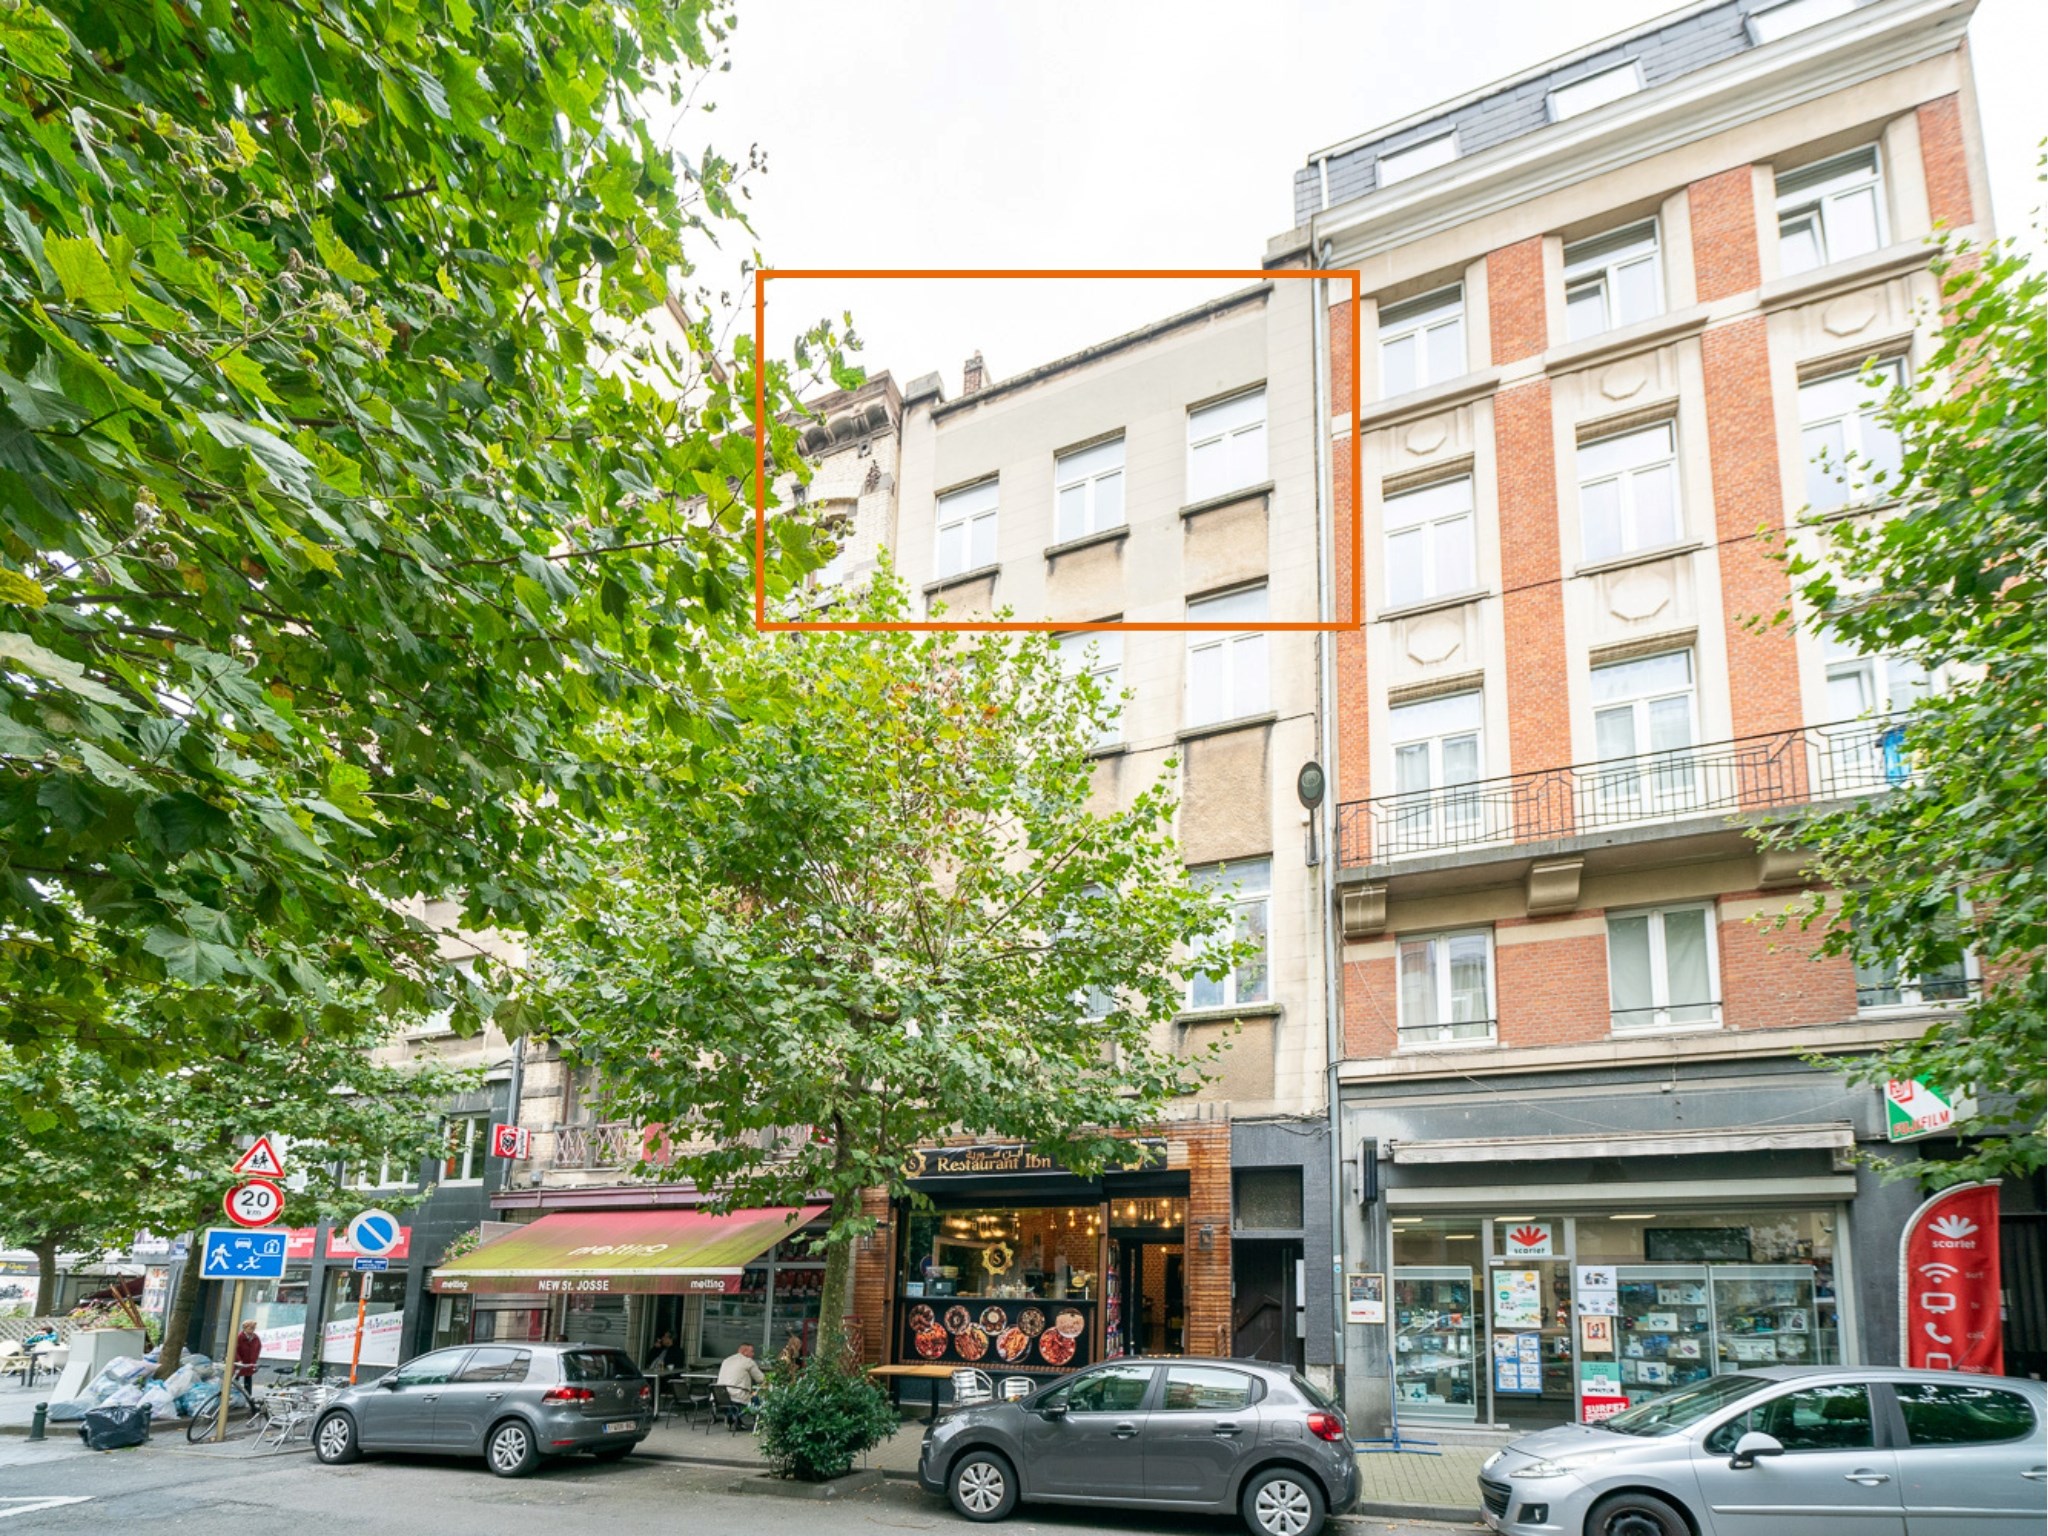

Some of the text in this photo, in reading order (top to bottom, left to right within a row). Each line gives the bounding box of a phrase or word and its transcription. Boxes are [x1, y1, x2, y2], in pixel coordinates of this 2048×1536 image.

[1893, 1110, 1949, 1137] FUJIFILM
[937, 1156, 1019, 1172] Restaurant
[1025, 1153, 1052, 1169] Ibn
[241, 1190, 270, 1208] 20
[246, 1208, 261, 1216] km
[1931, 1240, 1976, 1249] scarlet
[441, 1280, 469, 1291] melting
[538, 1280, 609, 1291] NEW St. JOSSE
[690, 1279, 726, 1292] melting
[1584, 1402, 1627, 1414] SURFEZ
